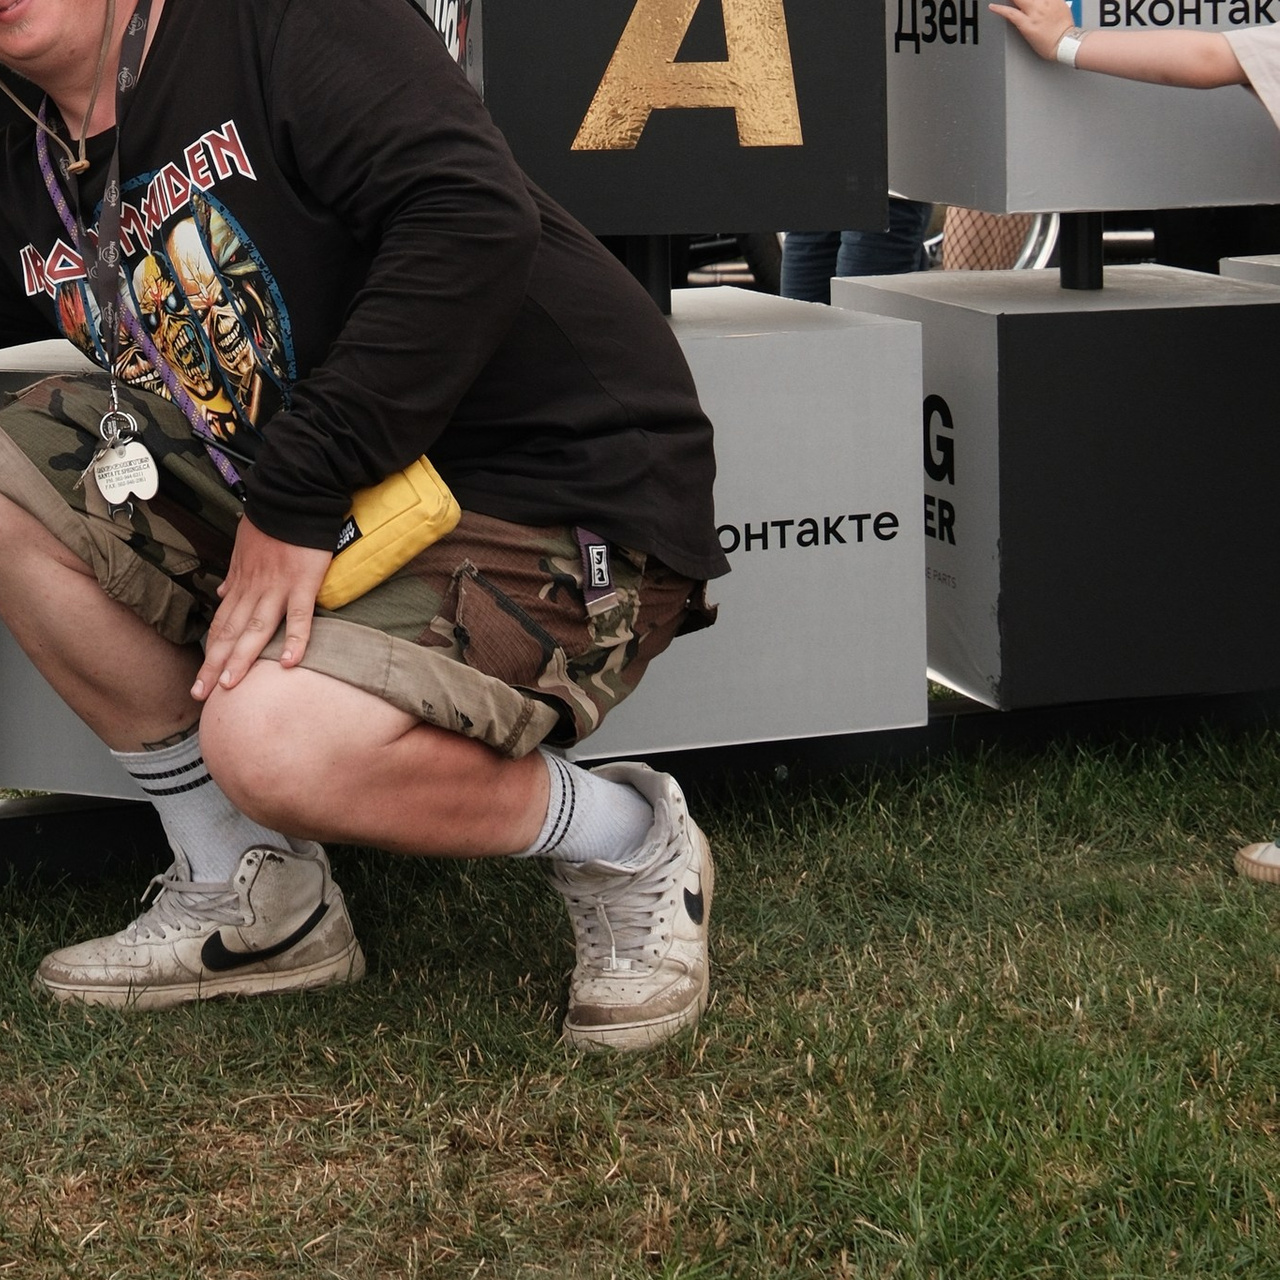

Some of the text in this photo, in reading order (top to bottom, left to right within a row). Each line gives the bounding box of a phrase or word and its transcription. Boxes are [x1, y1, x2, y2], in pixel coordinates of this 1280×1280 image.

[120, 119, 257, 257] MAIDEN
[716, 511, 899, 554] онтакте
[932, 569, 957, 589] PARTS
